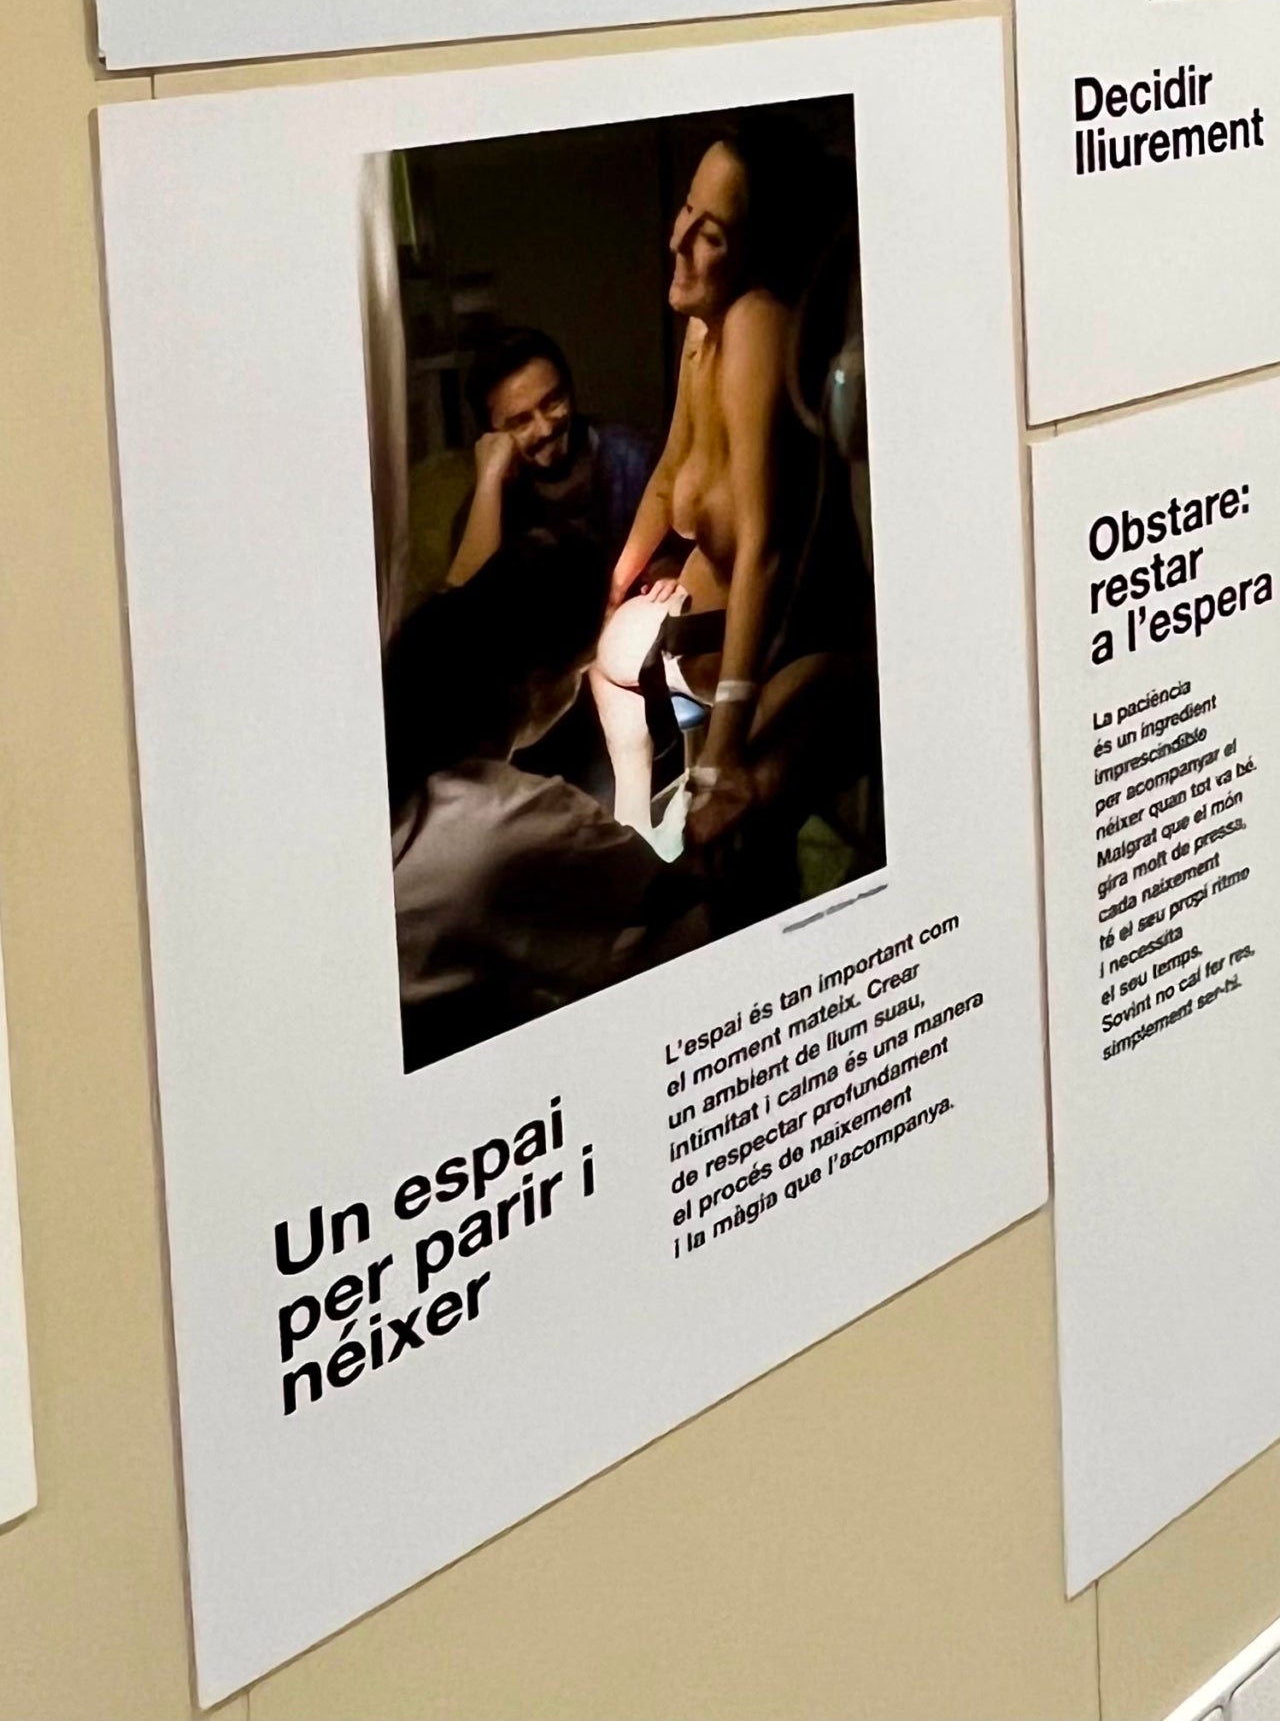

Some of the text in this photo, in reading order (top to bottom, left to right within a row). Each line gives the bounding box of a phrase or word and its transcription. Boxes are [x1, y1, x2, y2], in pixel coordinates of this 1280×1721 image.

[1074, 64, 1212, 122] Decidir
[1076, 108, 1264, 175] lliurement
[1089, 484, 1249, 561] Obstare:
[1090, 546, 1204, 614] restar
[1092, 573, 1272, 665] a l'espera
[666, 916, 959, 1065] L'espai és tan important com
[667, 1070, 686, 1097] el
[693, 1027, 782, 1085] moment
[867, 964, 920, 999] Crear
[668, 994, 925, 1129] un ambient de llum suau,
[670, 993, 983, 1162] intimitat i calma és una manera
[672, 1036, 948, 1194] de respectar profundament
[274, 1096, 563, 1275] Un espai
[673, 1085, 912, 1226] el procés de naixement
[674, 1238, 680, 1259] i
[687, 1230, 706, 1252] la
[713, 1192, 778, 1238] màgia
[784, 1168, 822, 1199] que
[278, 1144, 594, 1363] per parir i
[282, 1271, 490, 1416] néixer
